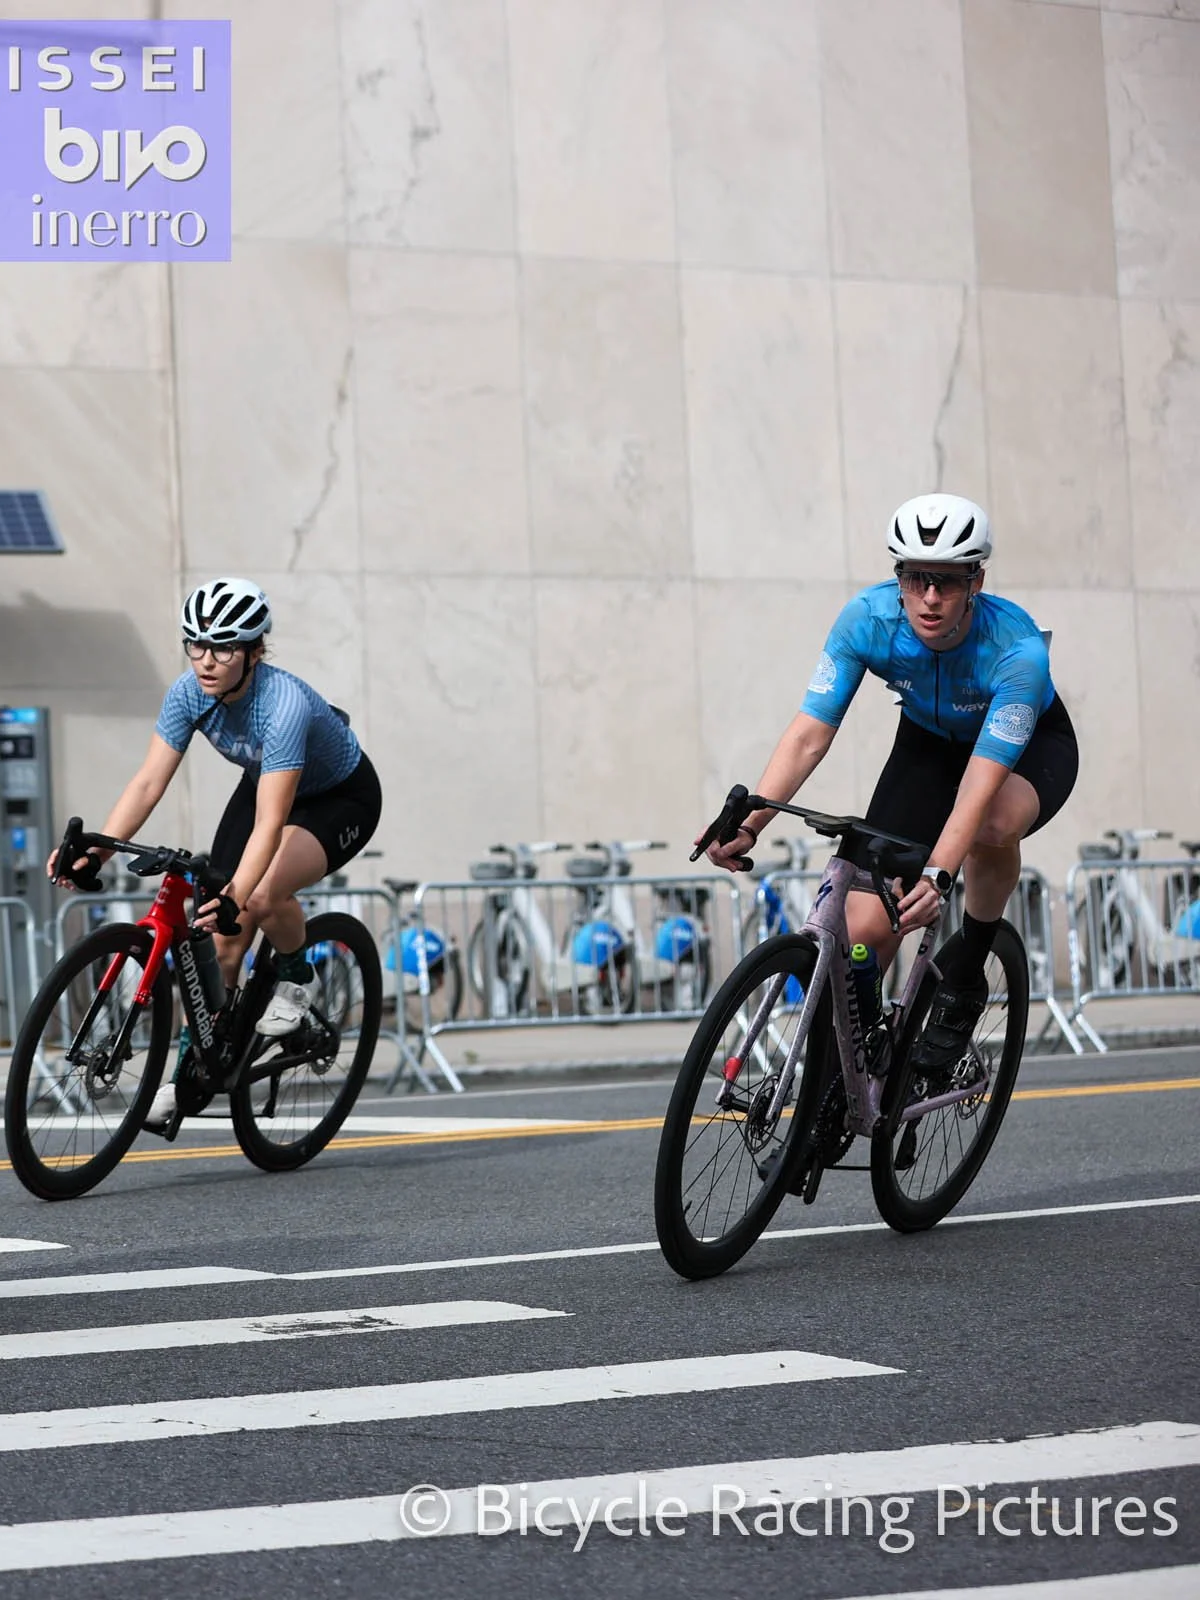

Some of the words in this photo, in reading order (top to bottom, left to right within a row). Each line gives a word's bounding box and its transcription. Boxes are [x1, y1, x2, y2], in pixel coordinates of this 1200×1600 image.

[952, 702, 989, 712] wav
[338, 824, 360, 850] Liv
[179, 939, 214, 1049] cannondale
